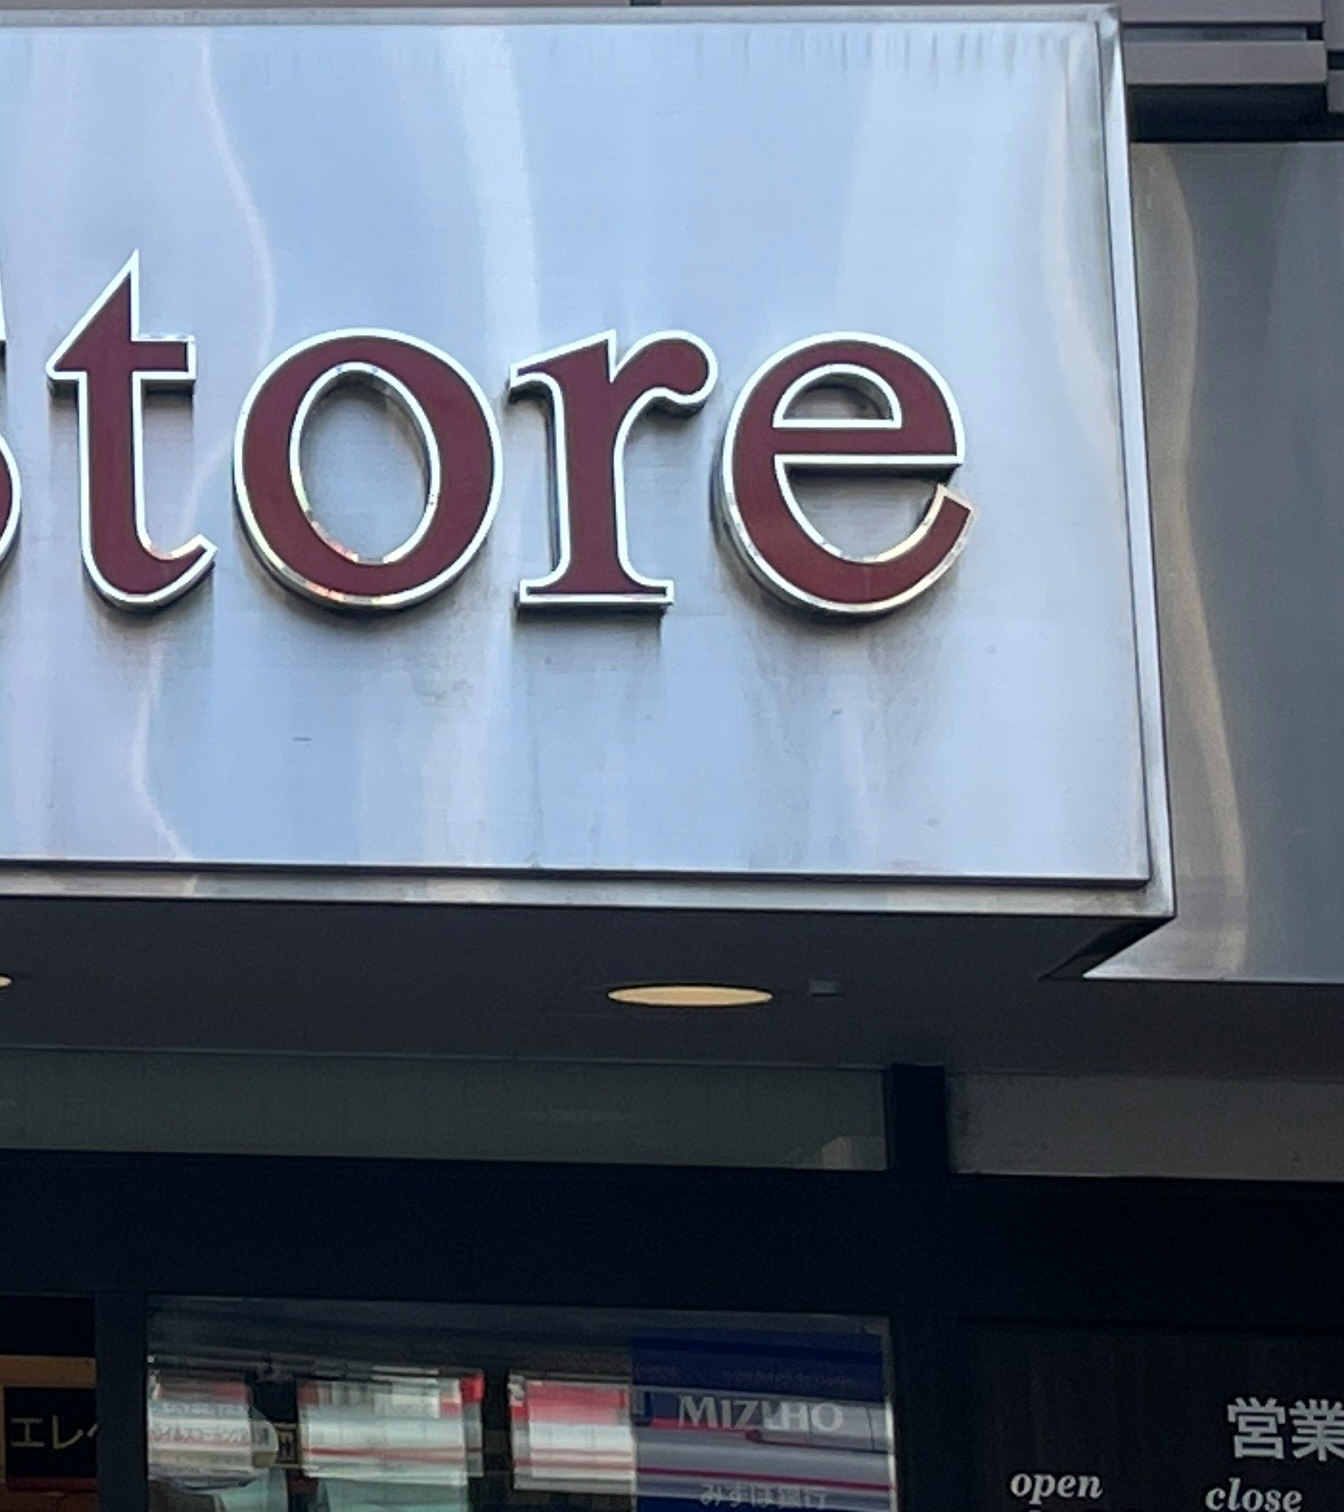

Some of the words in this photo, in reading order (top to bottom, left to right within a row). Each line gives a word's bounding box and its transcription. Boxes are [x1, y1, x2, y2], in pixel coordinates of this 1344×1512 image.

[1227, 1396, 1344, 1462] 営業
[1010, 1472, 1104, 1505] open
[1205, 1477, 1303, 1512] close
